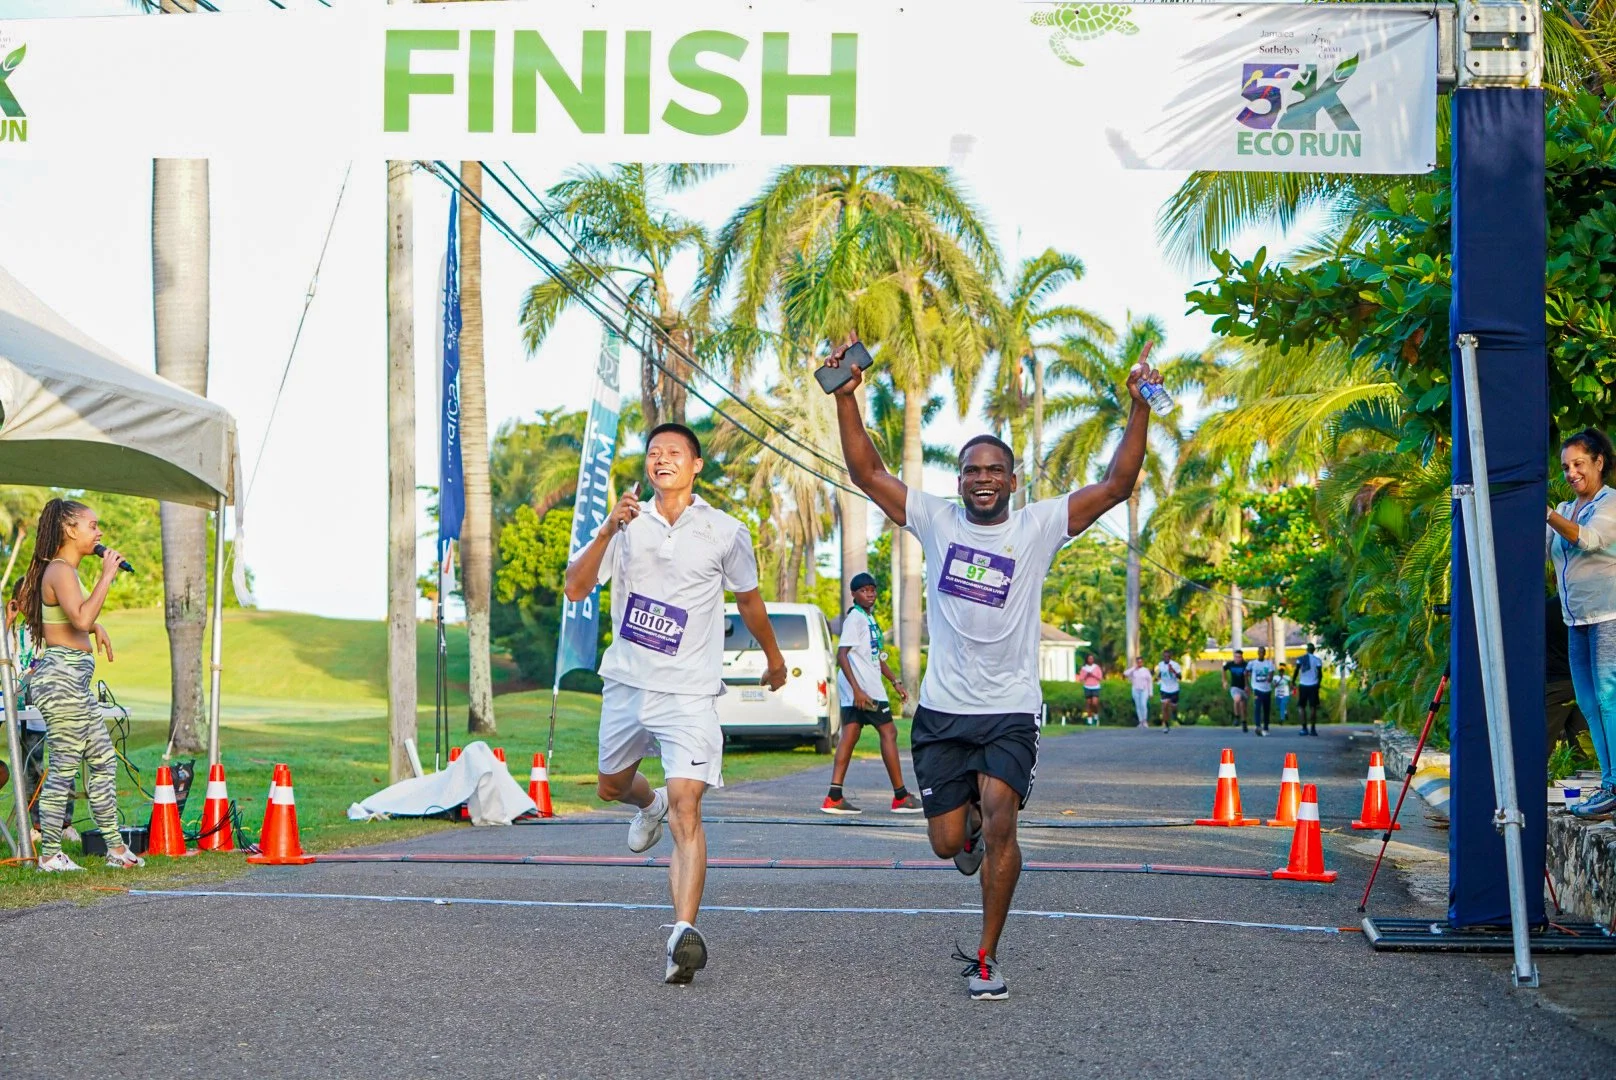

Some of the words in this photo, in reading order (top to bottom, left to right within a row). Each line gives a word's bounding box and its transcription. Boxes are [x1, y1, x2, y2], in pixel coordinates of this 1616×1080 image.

[1259, 45, 1300, 56] Sotheby's
[384, 29, 859, 137] FINISH
[1236, 63, 1360, 131] 5K
[1237, 131, 1294, 156] ECO
[1300, 132, 1361, 157] RUN
[965, 565, 987, 582] 97
[634, 610, 674, 633] 10107
